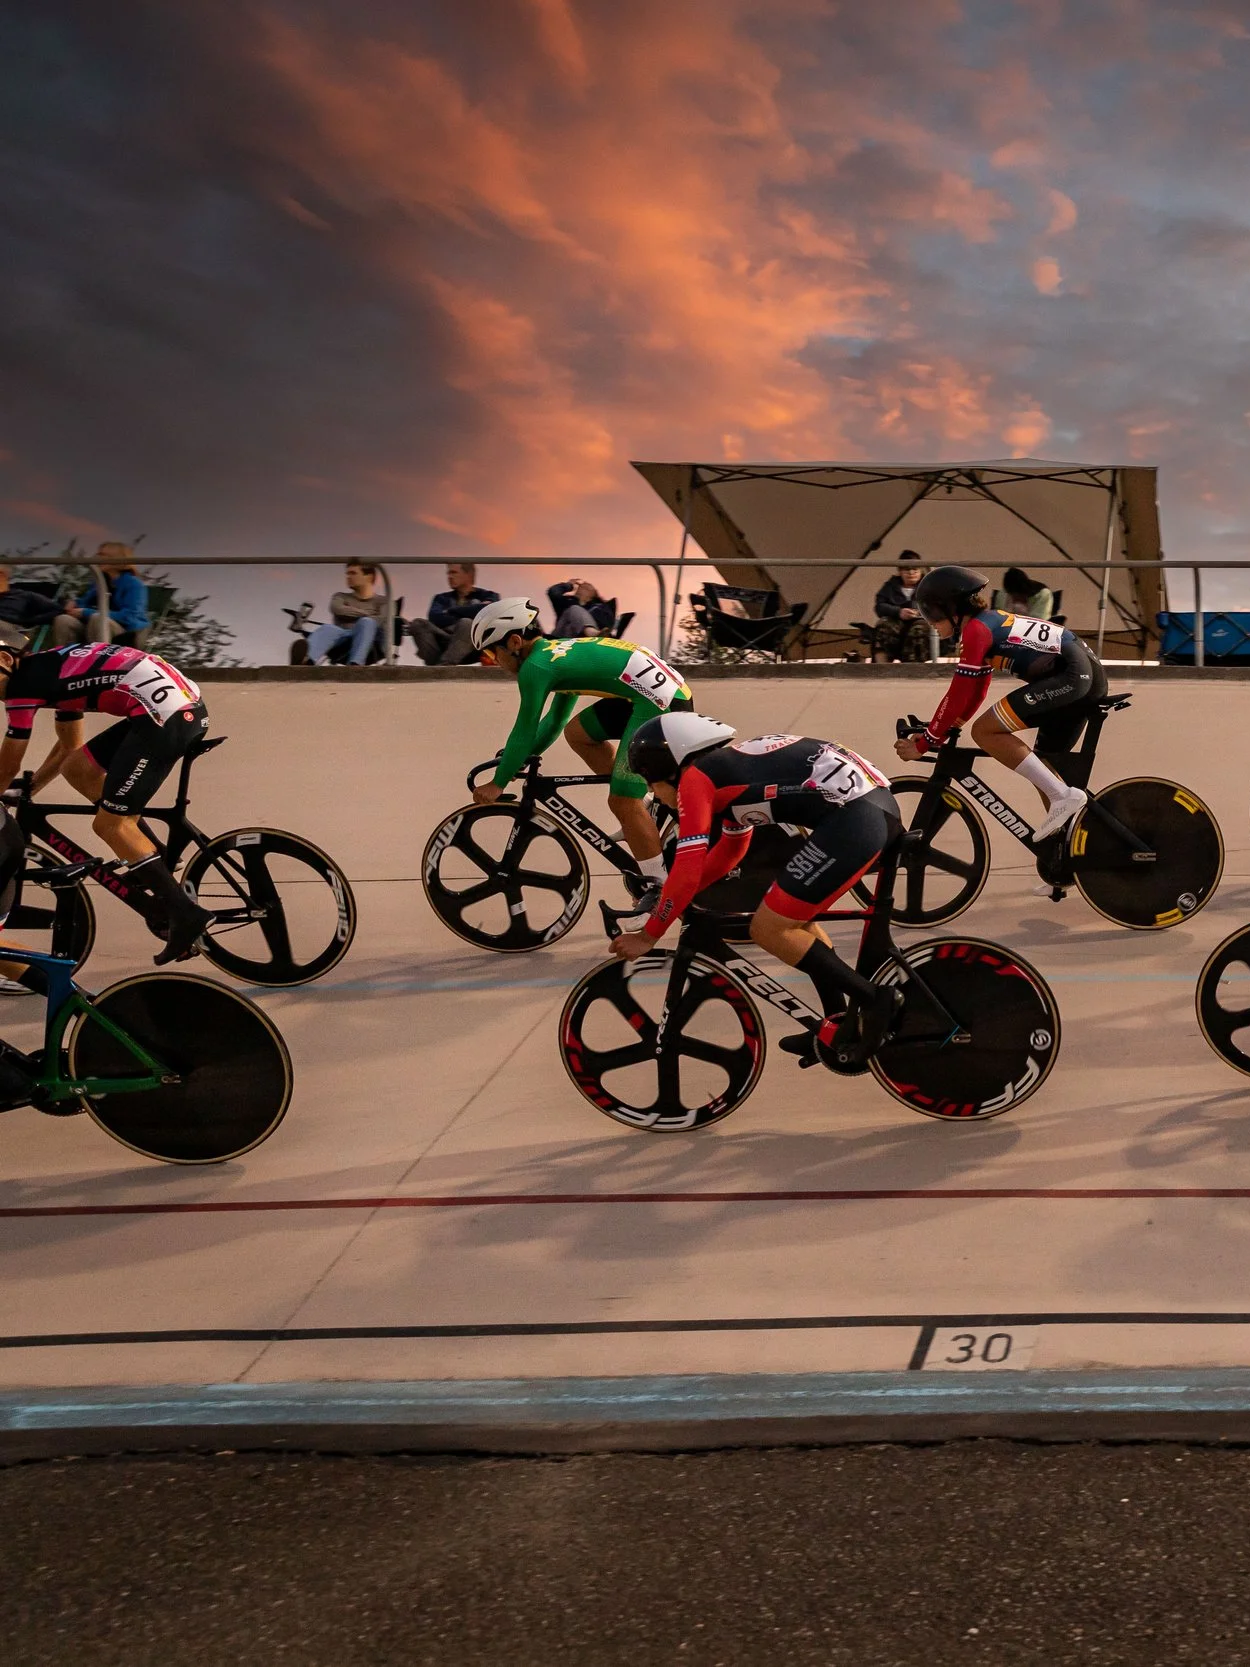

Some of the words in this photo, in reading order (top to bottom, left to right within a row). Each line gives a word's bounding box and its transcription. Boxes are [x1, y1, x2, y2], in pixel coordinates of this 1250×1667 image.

[1023, 620, 1051, 642] 78
[67, 674, 125, 691] CUTTERS
[135, 670, 175, 704] 76
[635, 659, 667, 690] 79
[115, 758, 149, 797] VELO-FLYER
[821, 756, 856, 795] 75
[545, 796, 612, 852] DOLAN
[960, 776, 1030, 839] STROMM
[786, 841, 827, 880] SBW
[94, 868, 129, 898] LYER
[725, 959, 825, 1021] FELT
[945, 1332, 1012, 1364] 30
